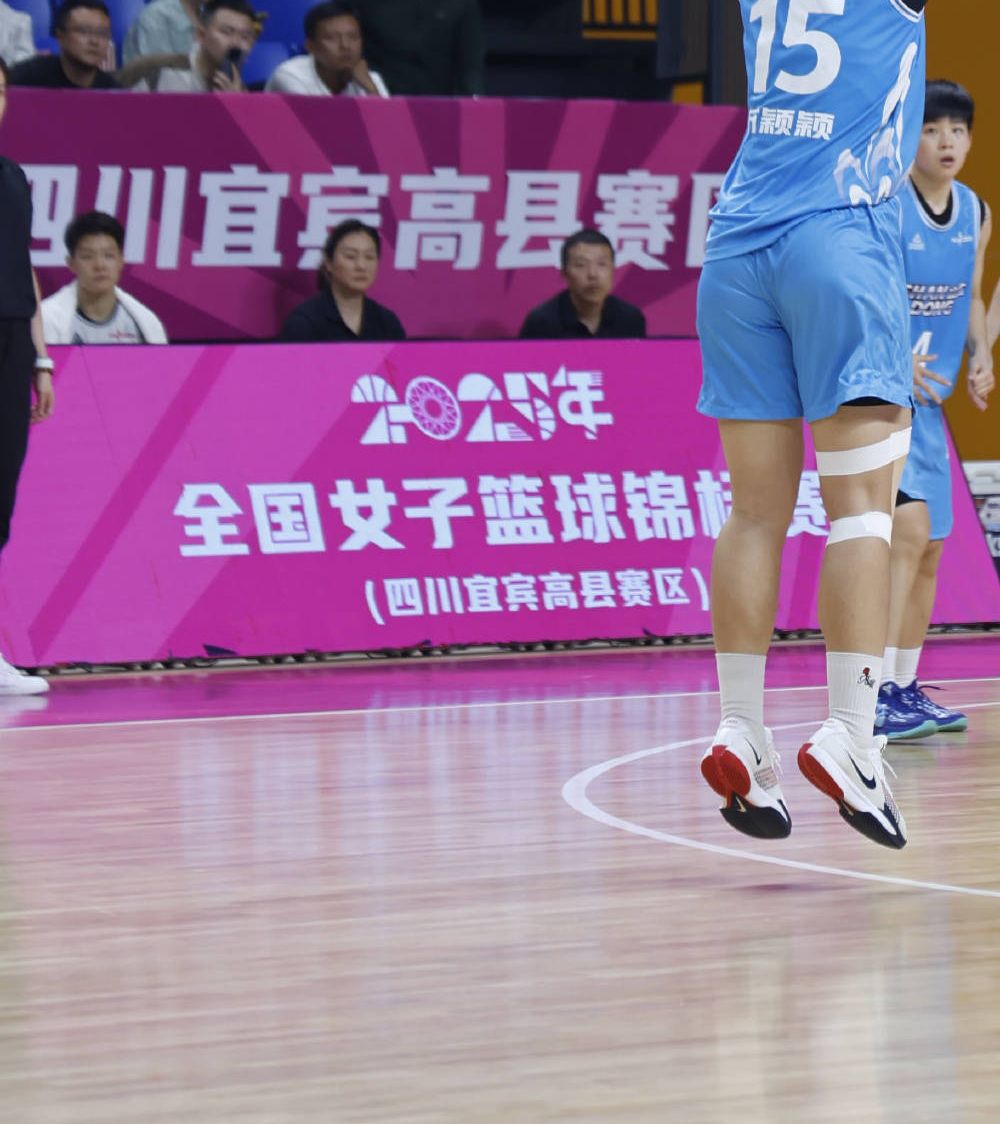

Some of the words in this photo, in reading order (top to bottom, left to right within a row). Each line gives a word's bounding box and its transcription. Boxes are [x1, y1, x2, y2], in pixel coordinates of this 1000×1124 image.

[910, 300, 954, 316] DONG
[351, 365, 613, 445] 2025年
[364, 567, 711, 626] (四川宜宾高县赛区)
